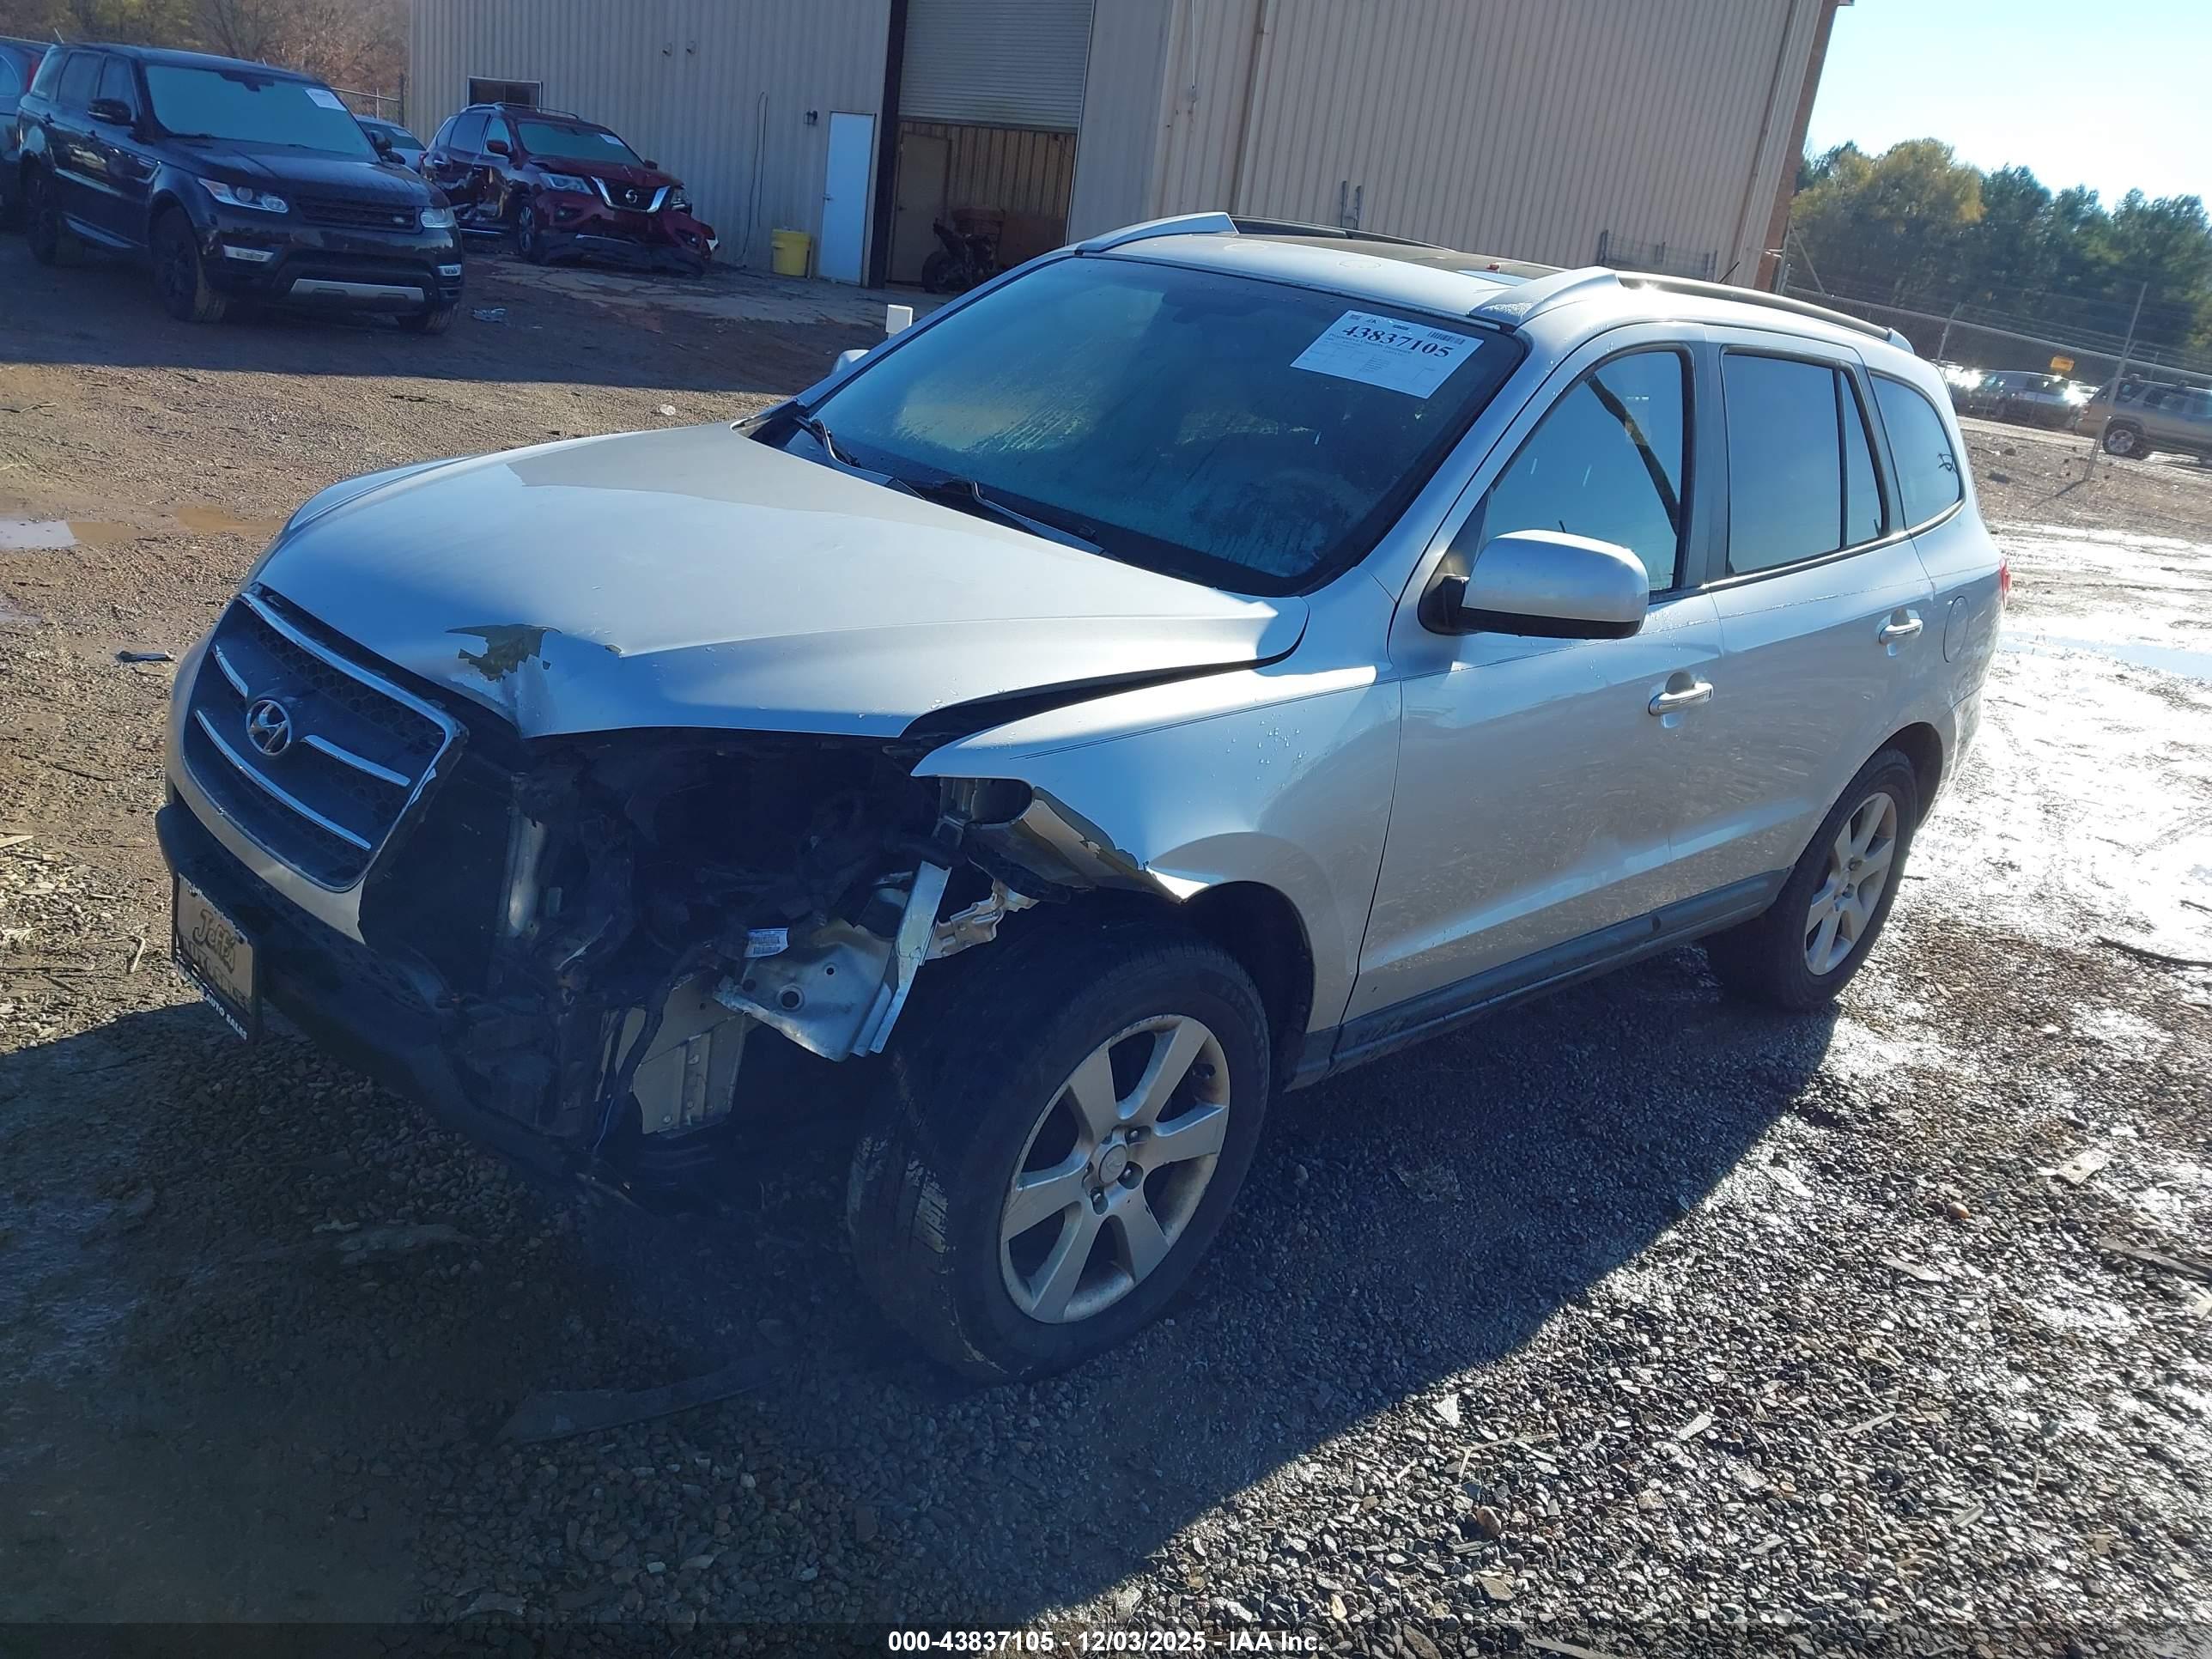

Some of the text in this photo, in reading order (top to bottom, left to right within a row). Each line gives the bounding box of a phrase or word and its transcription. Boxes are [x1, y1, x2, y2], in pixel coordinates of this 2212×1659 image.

[1341, 325, 1455, 358] 43837105
[205, 993, 249, 1041] AUTO SALES
